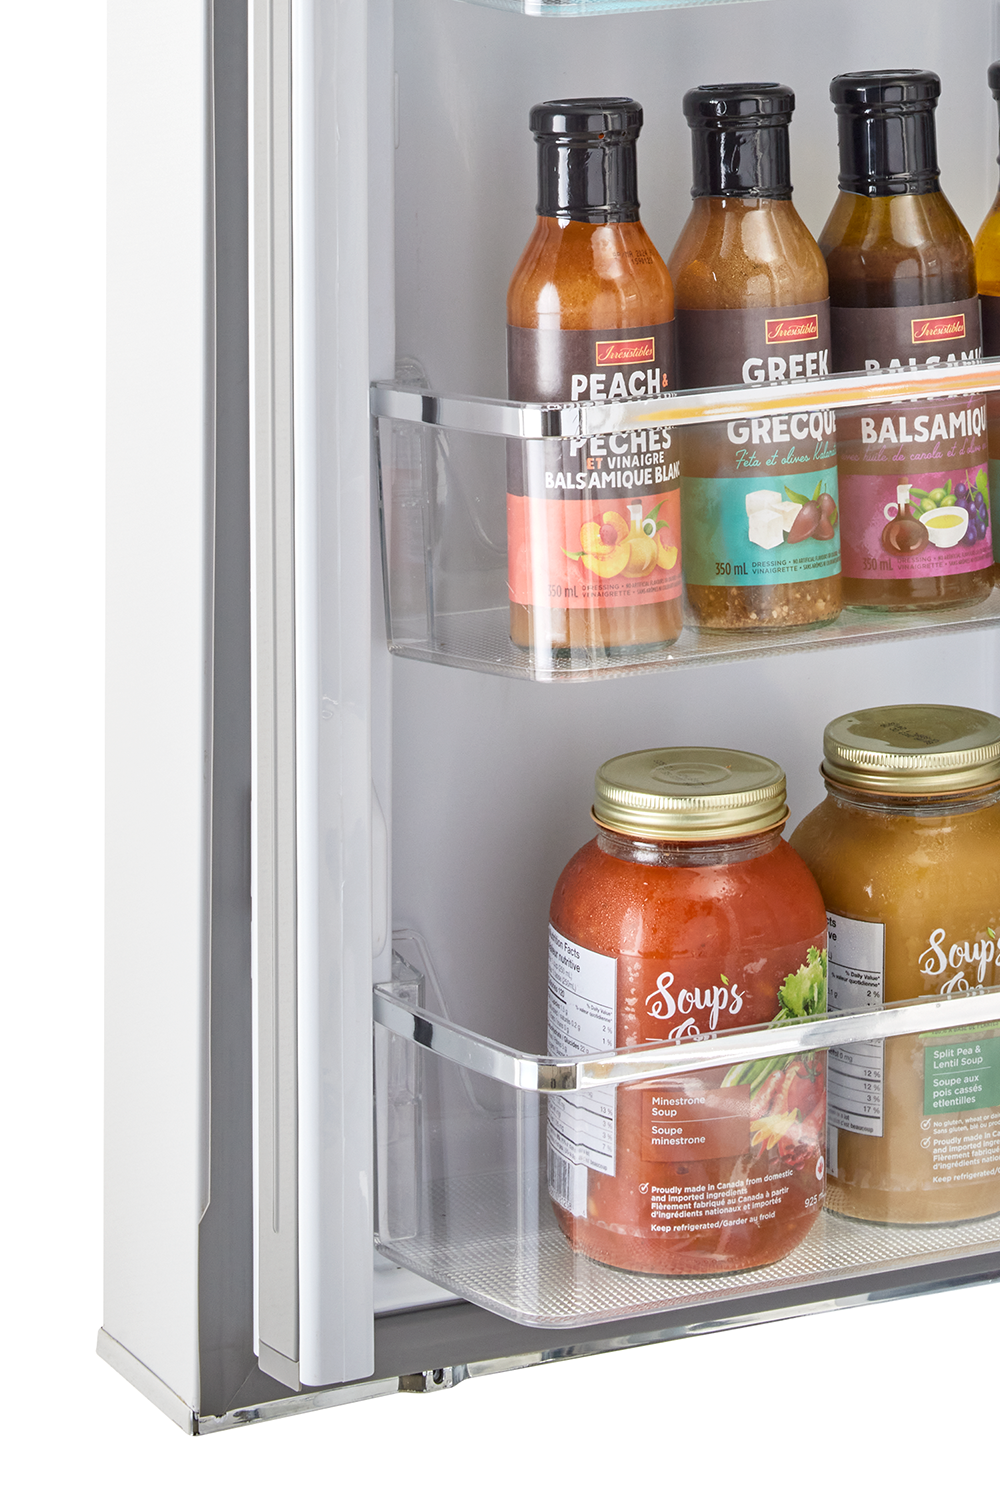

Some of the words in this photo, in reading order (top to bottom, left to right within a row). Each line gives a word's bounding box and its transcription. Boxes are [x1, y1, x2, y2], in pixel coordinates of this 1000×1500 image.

[742, 349, 829, 385] GREEK
[570, 368, 661, 401] PEACH
[662, 373, 668, 388] &
[861, 404, 987, 444] BALSAMIQU
[766, 450, 778, 466] et
[781, 446, 810, 465] olives
[892, 444, 905, 461] de
[910, 442, 943, 460] canola
[586, 457, 603, 470] ET
[607, 451, 664, 469] VINAIGRE
[545, 468, 652, 489] BALSAMIQUE
[715, 562, 731, 575] 350
[734, 562, 748, 575] mL
[752, 560, 787, 568] DRESSING
[752, 566, 798, 574] VINAIGRETTE
[862, 557, 878, 570] 350
[897, 562, 944, 570] VINAIGRETTE
[564, 585, 578, 598] mL
[934, 1050, 954, 1060] Split
[957, 1047, 973, 1055] Pea
[934, 1058, 959, 1069] Lentil
[961, 1056, 983, 1066] Soup
[933, 1077, 961, 1087] Soupe
[964, 1075, 979, 1083] aux
[933, 1088, 952, 1099] pois
[954, 1084, 982, 1094] cassés
[652, 1097, 706, 1106] Minestrone
[652, 1108, 677, 1118] Soup
[651, 1126, 683, 1136] Soupe
[651, 1136, 706, 1145] minestrone
[933, 1137, 962, 1146] Proudly
[964, 1134, 982, 1142] made
[651, 1185, 683, 1195] Proudly
[684, 1185, 706, 1193] made
[716, 1180, 744, 1190] Canada
[745, 1176, 763, 1186] from
[763, 1169, 794, 1182] domestic
[651, 1194, 667, 1202] and
[693, 1198, 726, 1209] fabriqué
[737, 1192, 764, 1204] Canada
[804, 1195, 818, 1208] 925
[704, 1205, 742, 1216] nationaux
[752, 1196, 782, 1209] importés
[651, 1224, 671, 1233] Keep
[673, 1217, 748, 1231] refrigerated/Garder
[759, 1211, 776, 1221] froid
